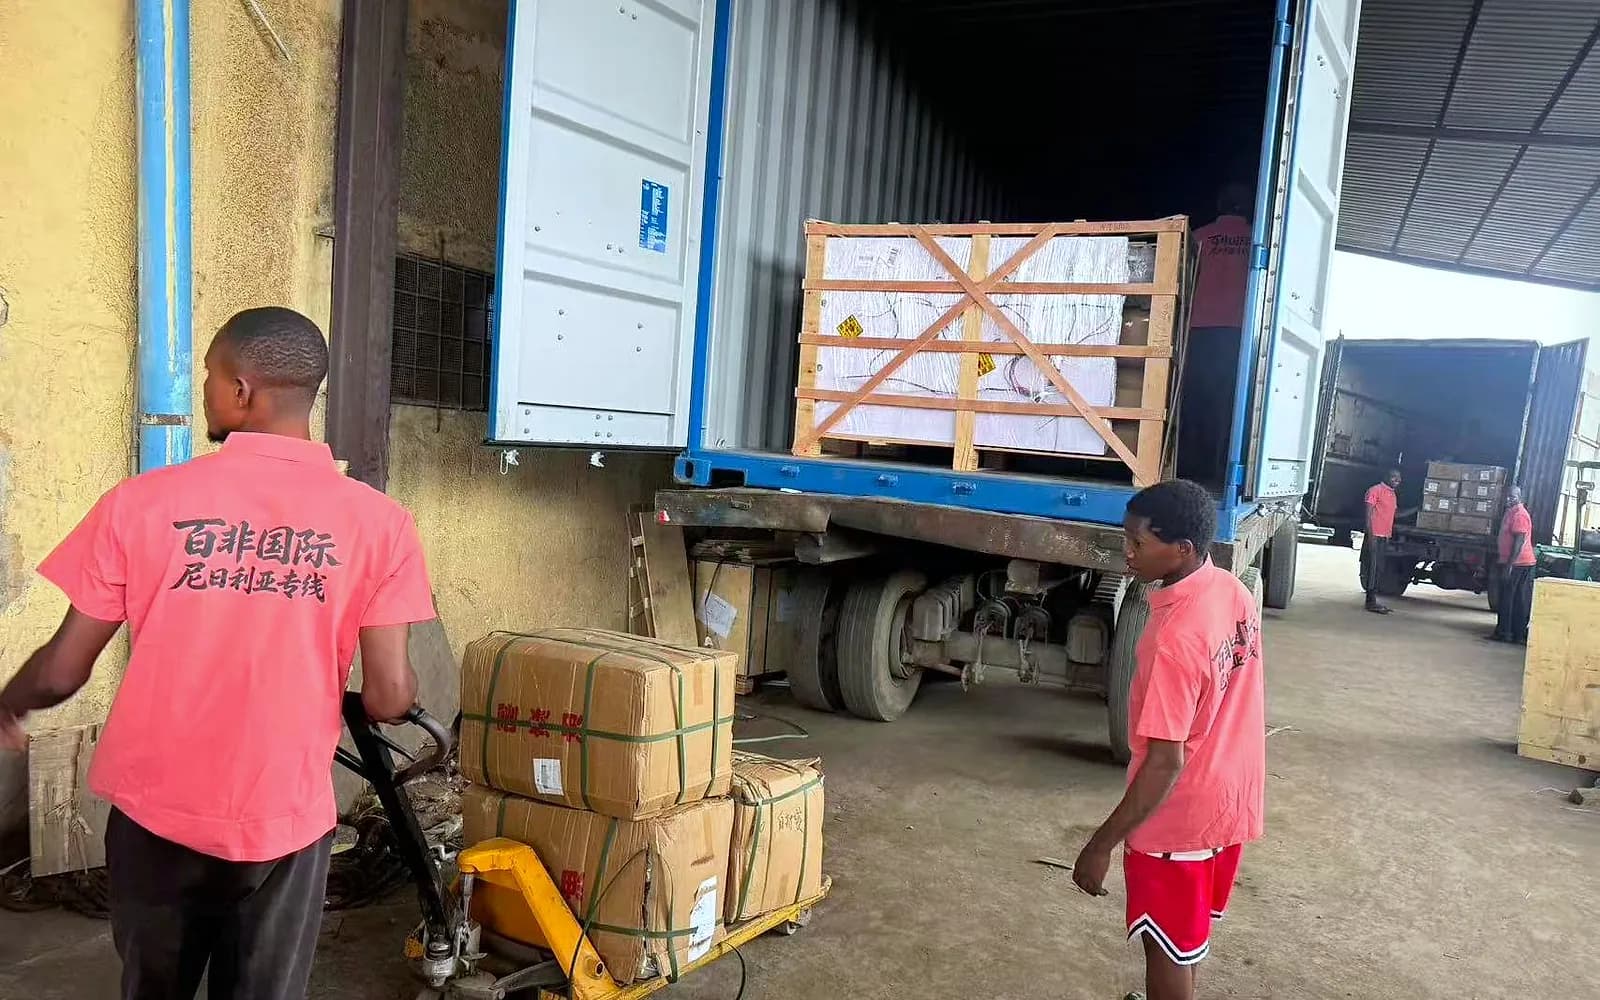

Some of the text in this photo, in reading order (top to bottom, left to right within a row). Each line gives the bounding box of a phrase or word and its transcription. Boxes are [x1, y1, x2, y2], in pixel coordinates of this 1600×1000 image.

[173, 518, 342, 568] 百非国际
[169, 562, 327, 602] 尼日利亚专线
